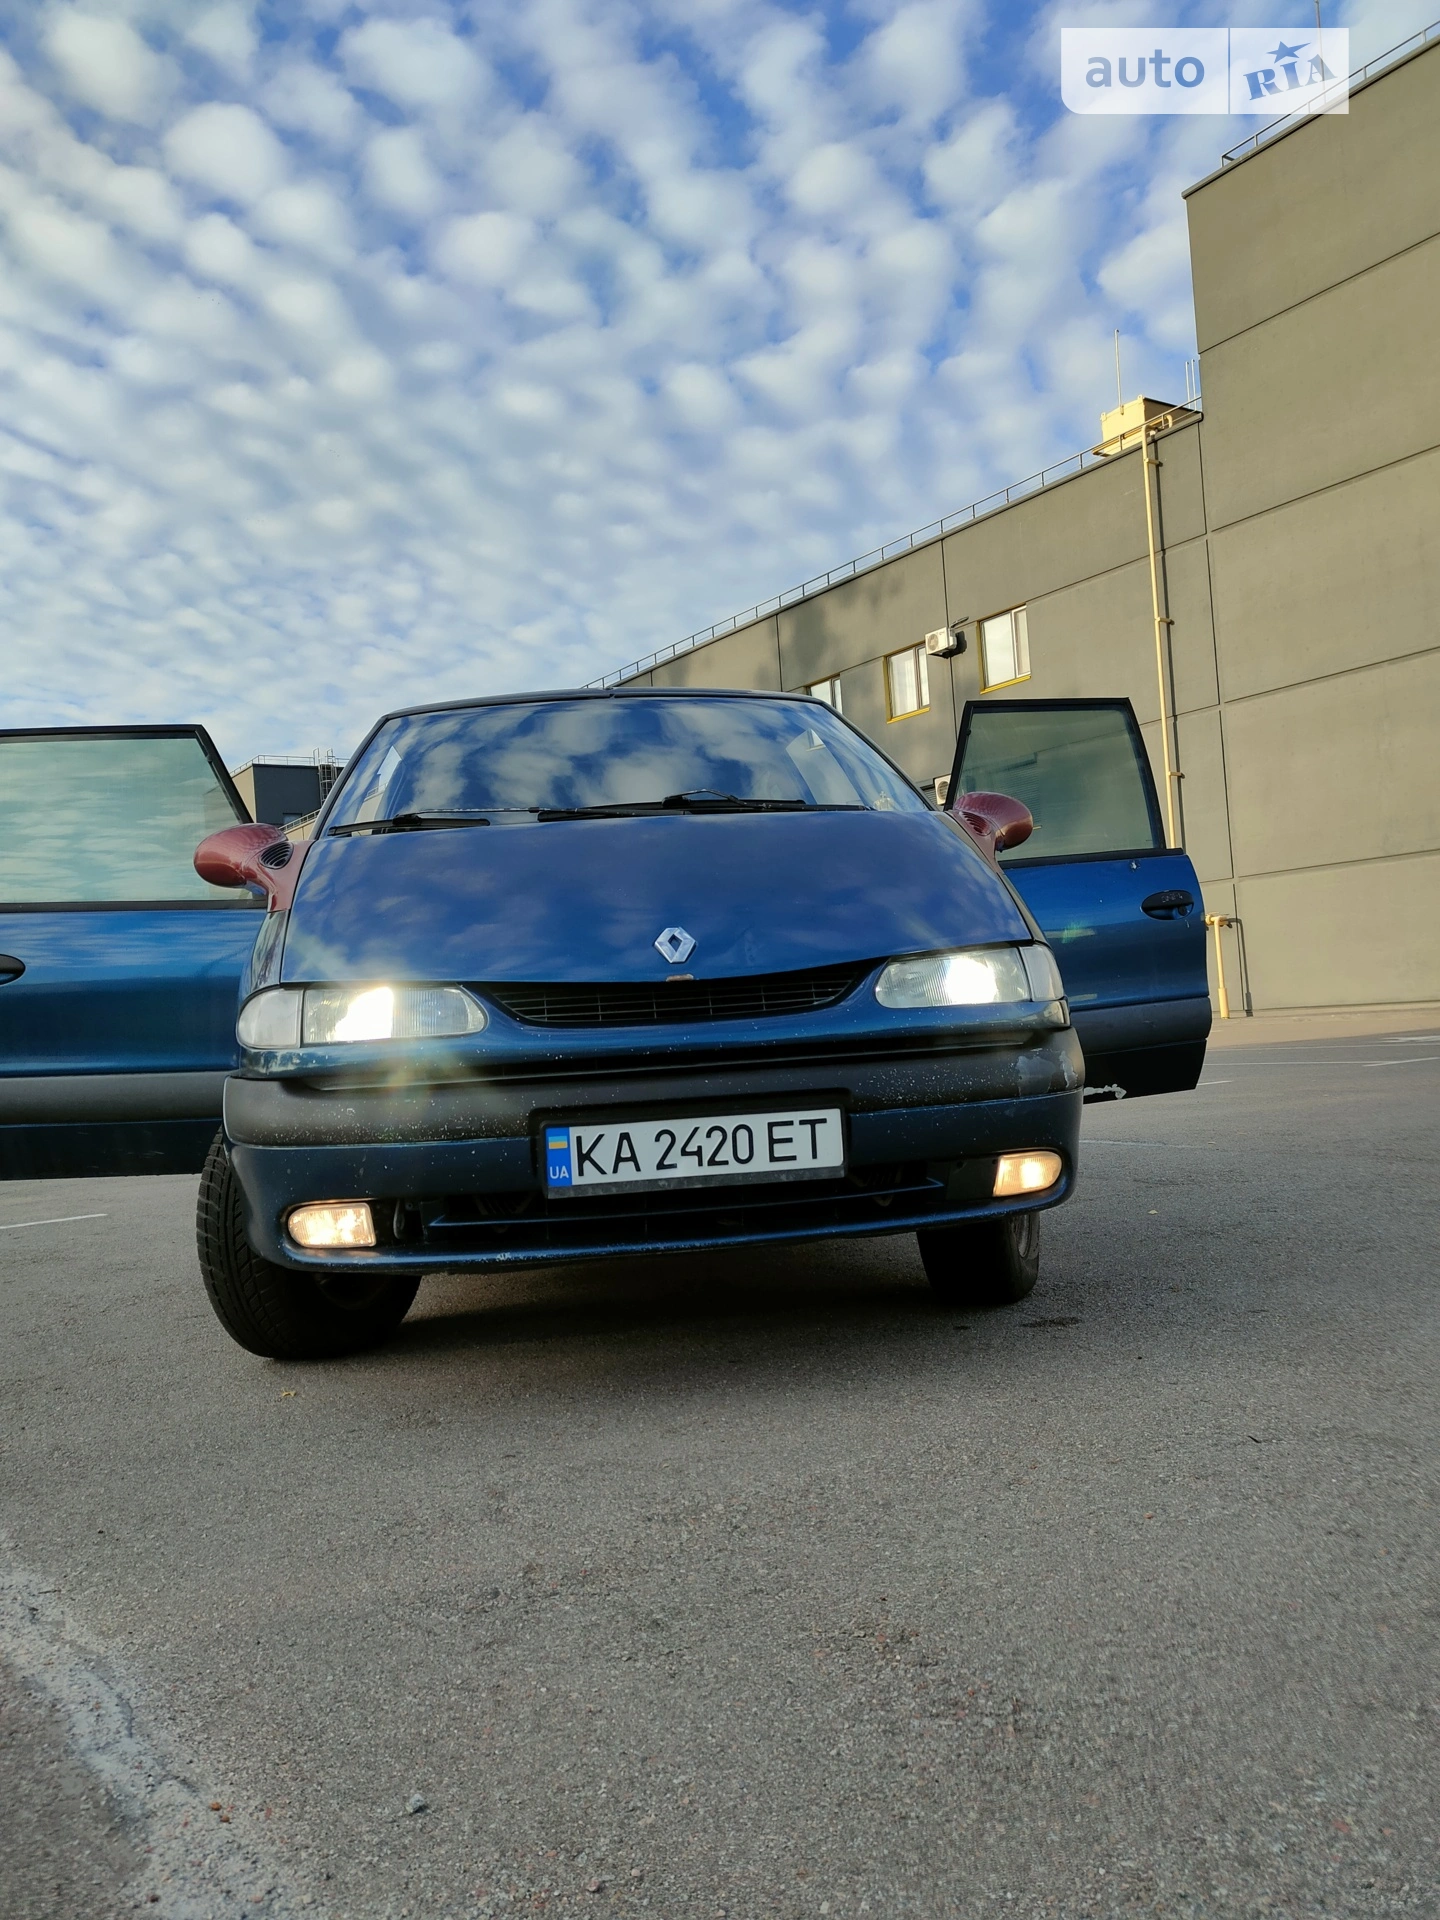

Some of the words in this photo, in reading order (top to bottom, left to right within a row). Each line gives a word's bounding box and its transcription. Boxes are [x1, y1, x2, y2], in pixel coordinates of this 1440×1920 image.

[575, 1132, 641, 1177] KA
[654, 1124, 754, 1170] 2420
[767, 1118, 827, 1163] ET
[549, 1166, 569, 1179] UA
